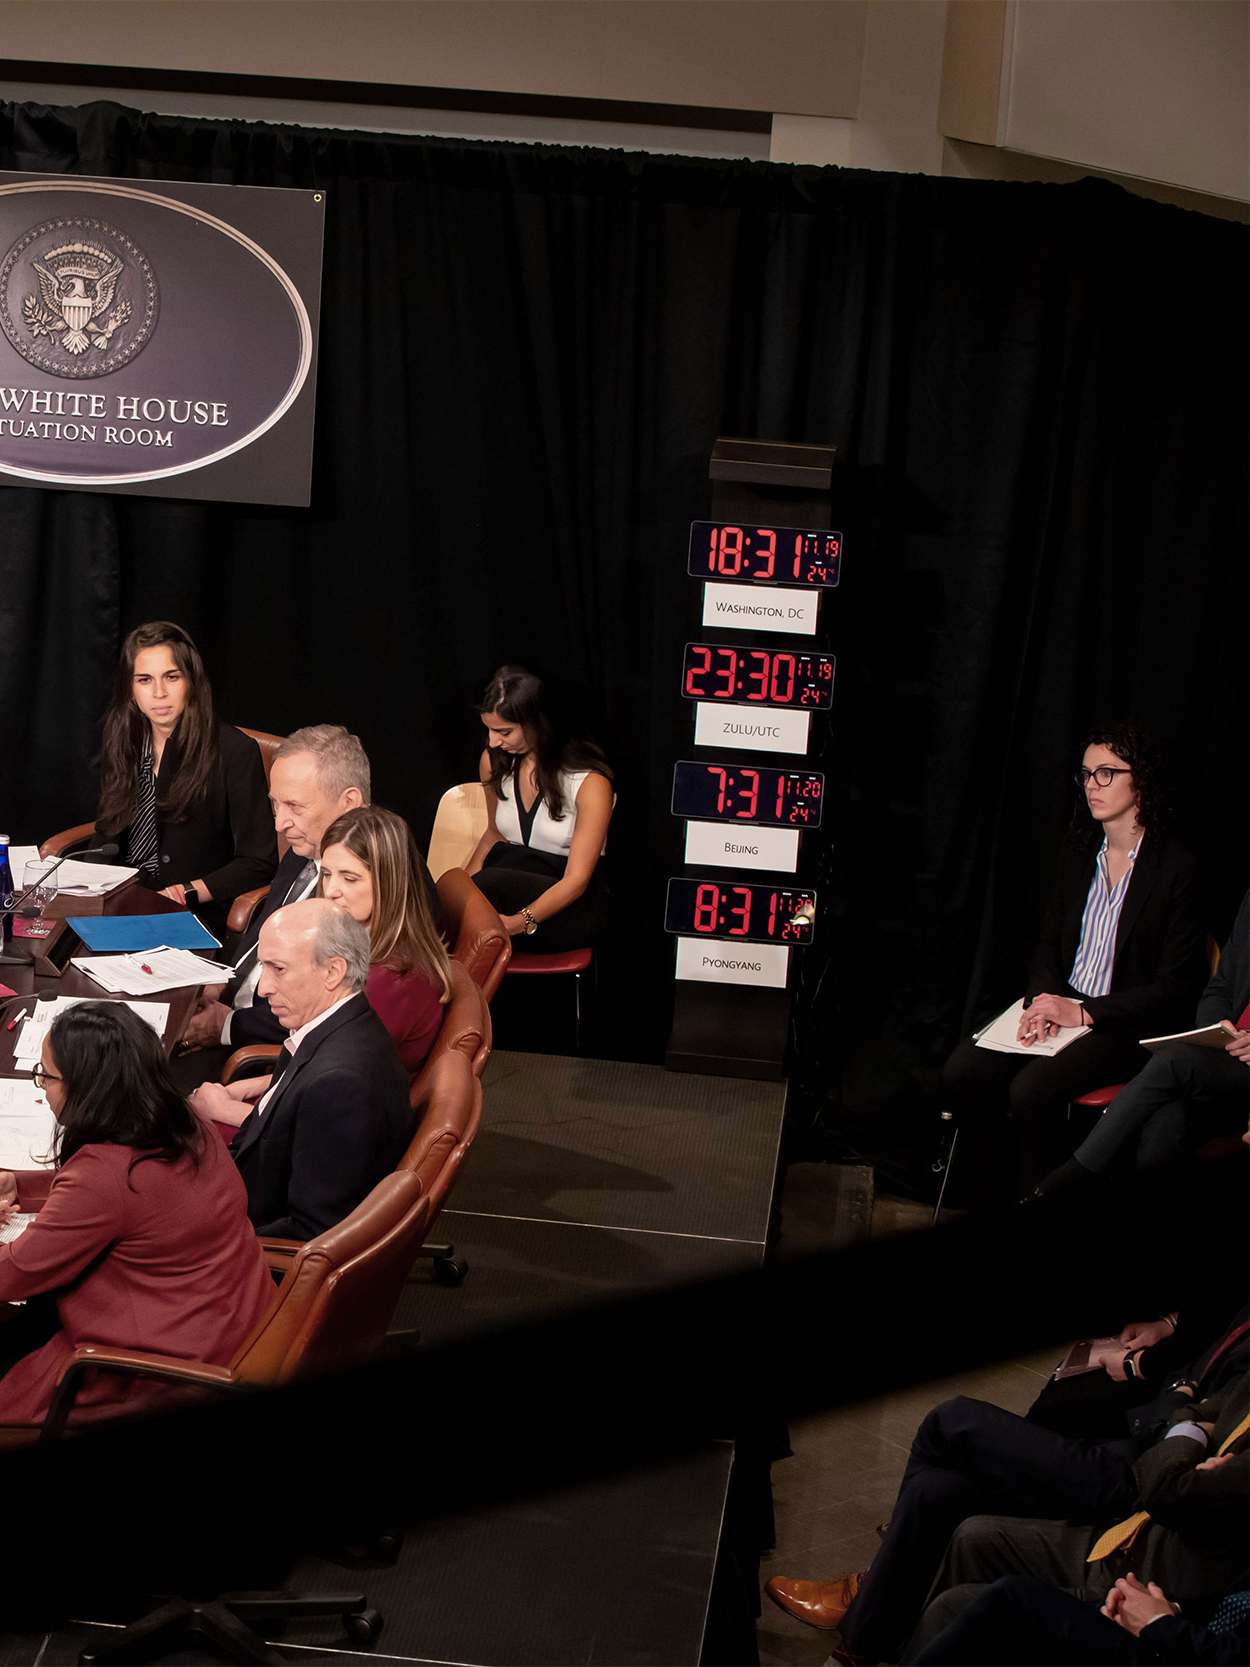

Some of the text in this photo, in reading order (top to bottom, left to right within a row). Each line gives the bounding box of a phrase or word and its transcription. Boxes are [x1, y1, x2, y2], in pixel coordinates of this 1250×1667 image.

[116, 396, 229, 426] HOUSE
[104, 426, 174, 447] ROOM
[708, 526, 803, 579] 18:31
[787, 608, 805, 620] DC
[685, 646, 796, 703] 23:30
[722, 722, 781, 738] ZULU/UTC
[706, 766, 785, 819] 7:31
[693, 883, 778, 936] 8:31
